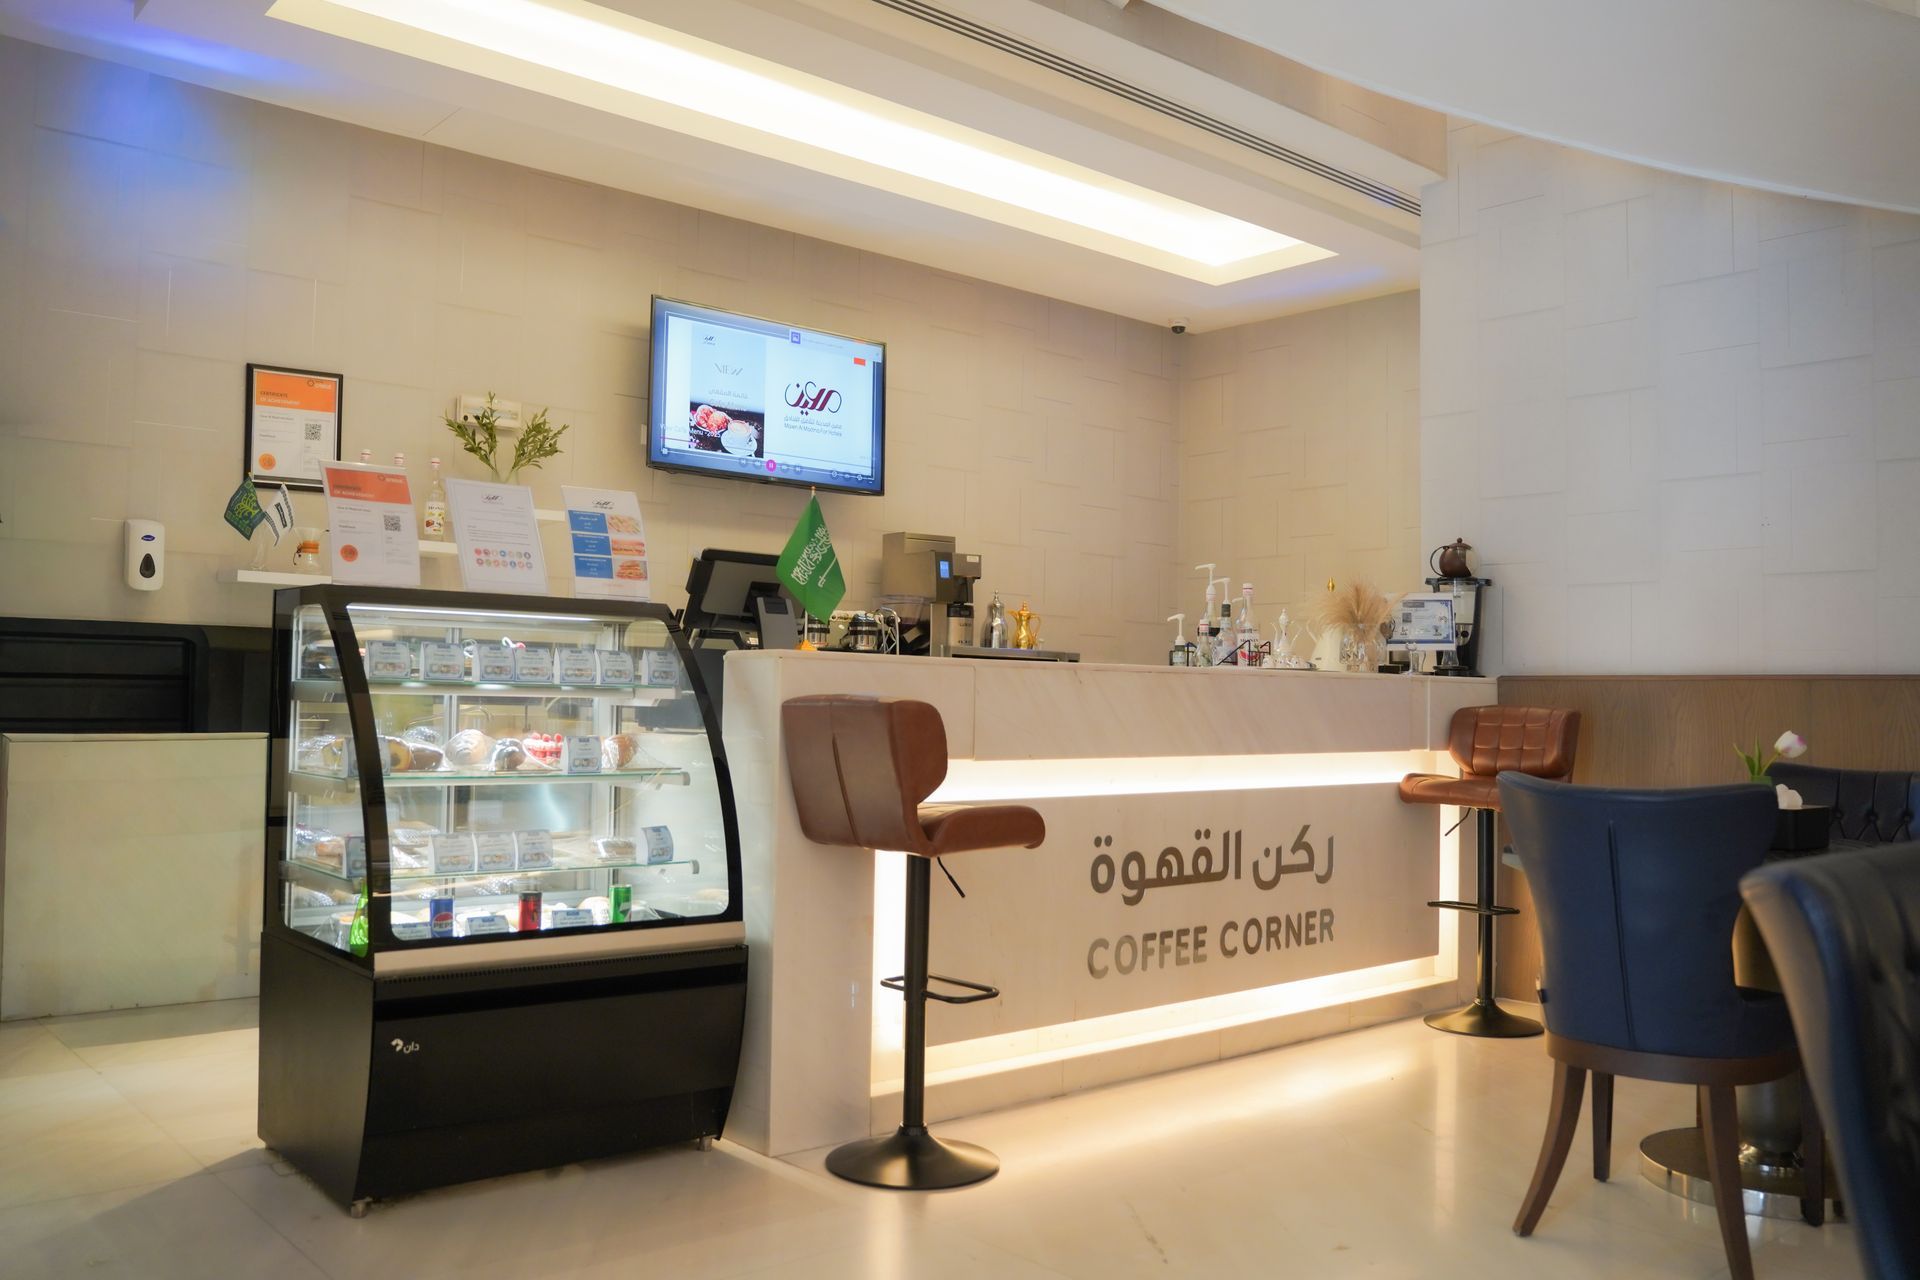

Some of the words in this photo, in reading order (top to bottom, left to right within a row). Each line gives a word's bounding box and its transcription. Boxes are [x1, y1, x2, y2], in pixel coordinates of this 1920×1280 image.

[1090, 828, 1242, 906] القهوة
[1252, 824, 1334, 891] ركن
[1087, 925, 1208, 979] COFFEE
[1219, 908, 1335, 959] CORNER
